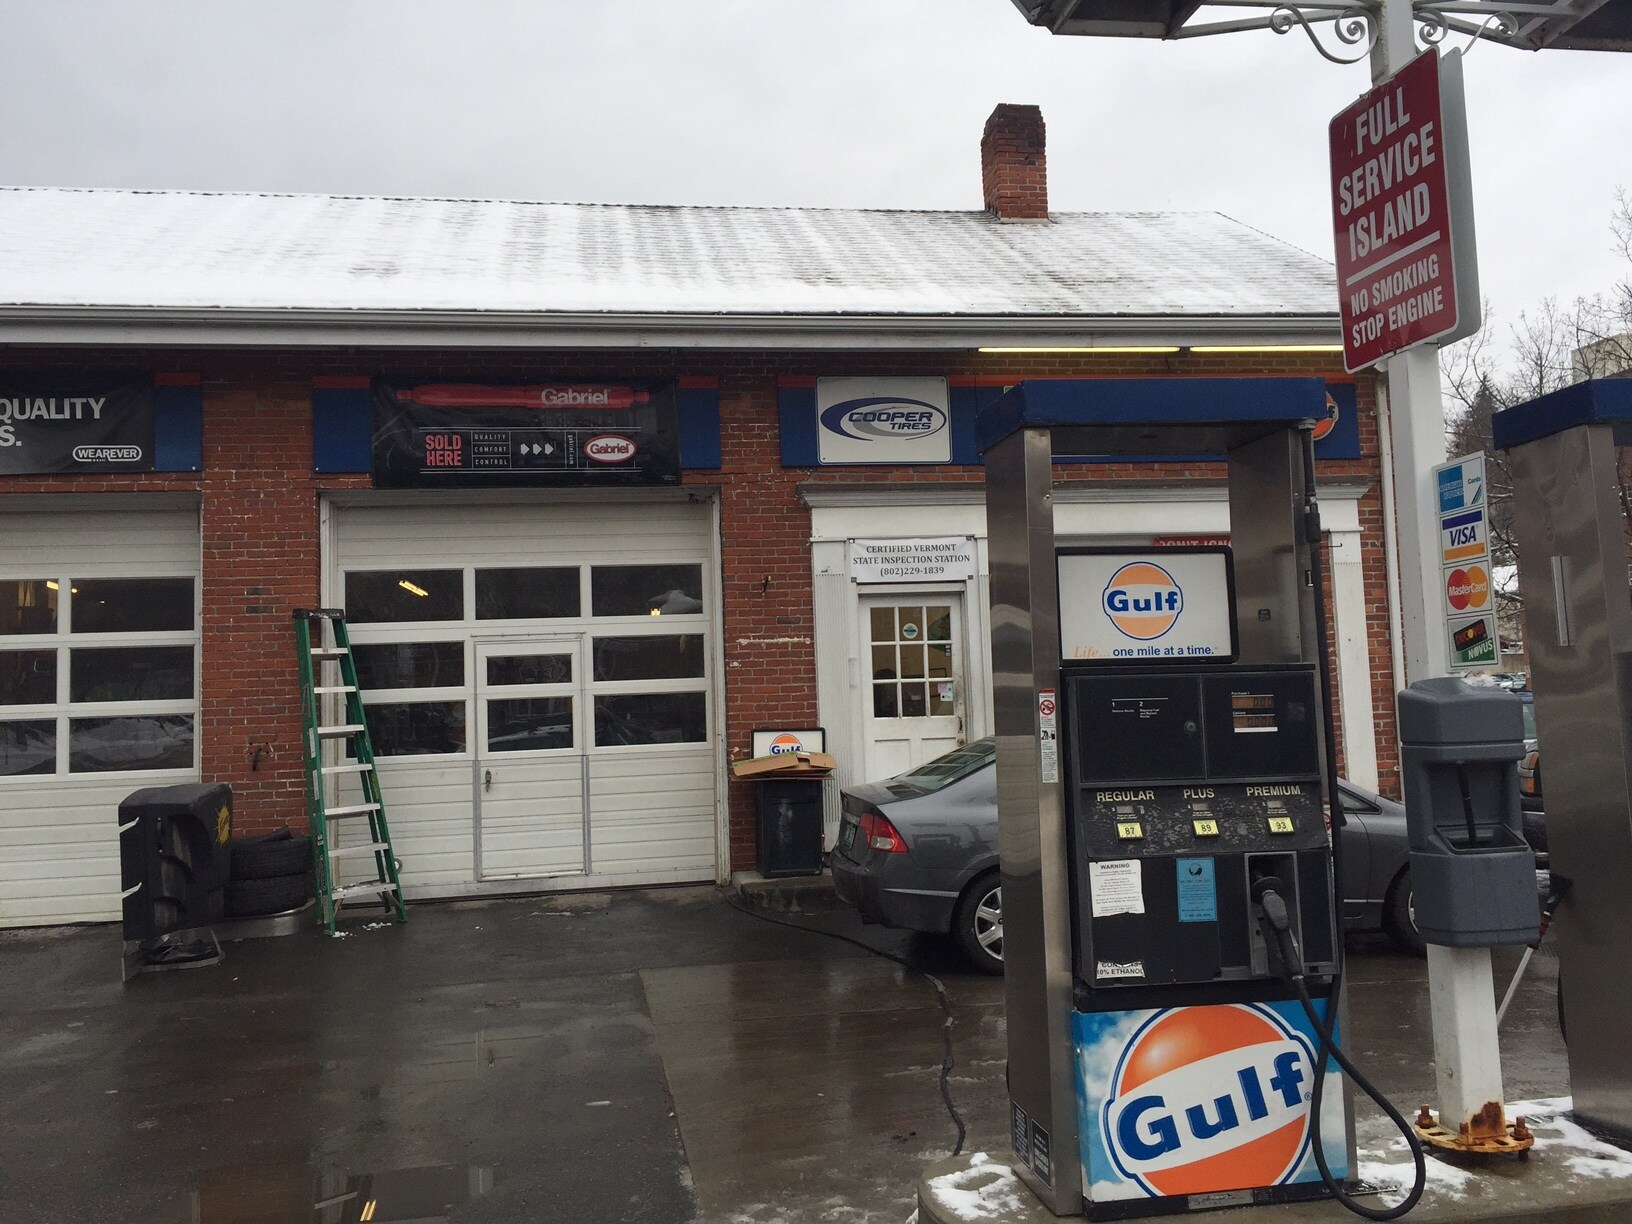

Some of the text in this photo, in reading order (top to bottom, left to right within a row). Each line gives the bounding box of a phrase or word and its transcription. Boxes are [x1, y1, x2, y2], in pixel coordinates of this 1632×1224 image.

[1356, 87, 1410, 155] FULL
[1339, 121, 1436, 216] SERVICE
[1348, 182, 1431, 262] ISLAND
[1351, 253, 1439, 317] NO SMOKING
[1352, 285, 1444, 348] STOP ENGINE
[541, 388, 608, 405] Gabriel
[0, 397, 106, 423] QUALITY
[848, 411, 933, 422] COOPER
[889, 422, 931, 430] TIRES
[425, 434, 462, 450] SOLD
[77, 449, 138, 459] WEAREVER
[590, 443, 630, 455] Gabriel
[426, 450, 462, 466] HERE
[1449, 525, 1477, 546] VISA
[866, 544, 957, 553] CERTIFIED VERMONT
[852, 554, 970, 565] STATE INSPECTION STATION
[880, 566, 944, 577] (802)229-1839
[1448, 582, 1487, 596] MasterCard
[1107, 590, 1178, 612] Gulf
[1113, 648, 1134, 656] one
[1137, 645, 1161, 656] mile
[1163, 646, 1175, 655] at
[1187, 644, 1214, 655] time.
[1097, 790, 1155, 802] REGULAR
[1183, 788, 1215, 799] PLUS
[1246, 785, 1301, 796] PREMIUM
[1125, 827, 1135, 835] 87
[1201, 824, 1212, 832] 89
[1276, 821, 1287, 830] 93
[1117, 1051, 1305, 1161] Gulf
